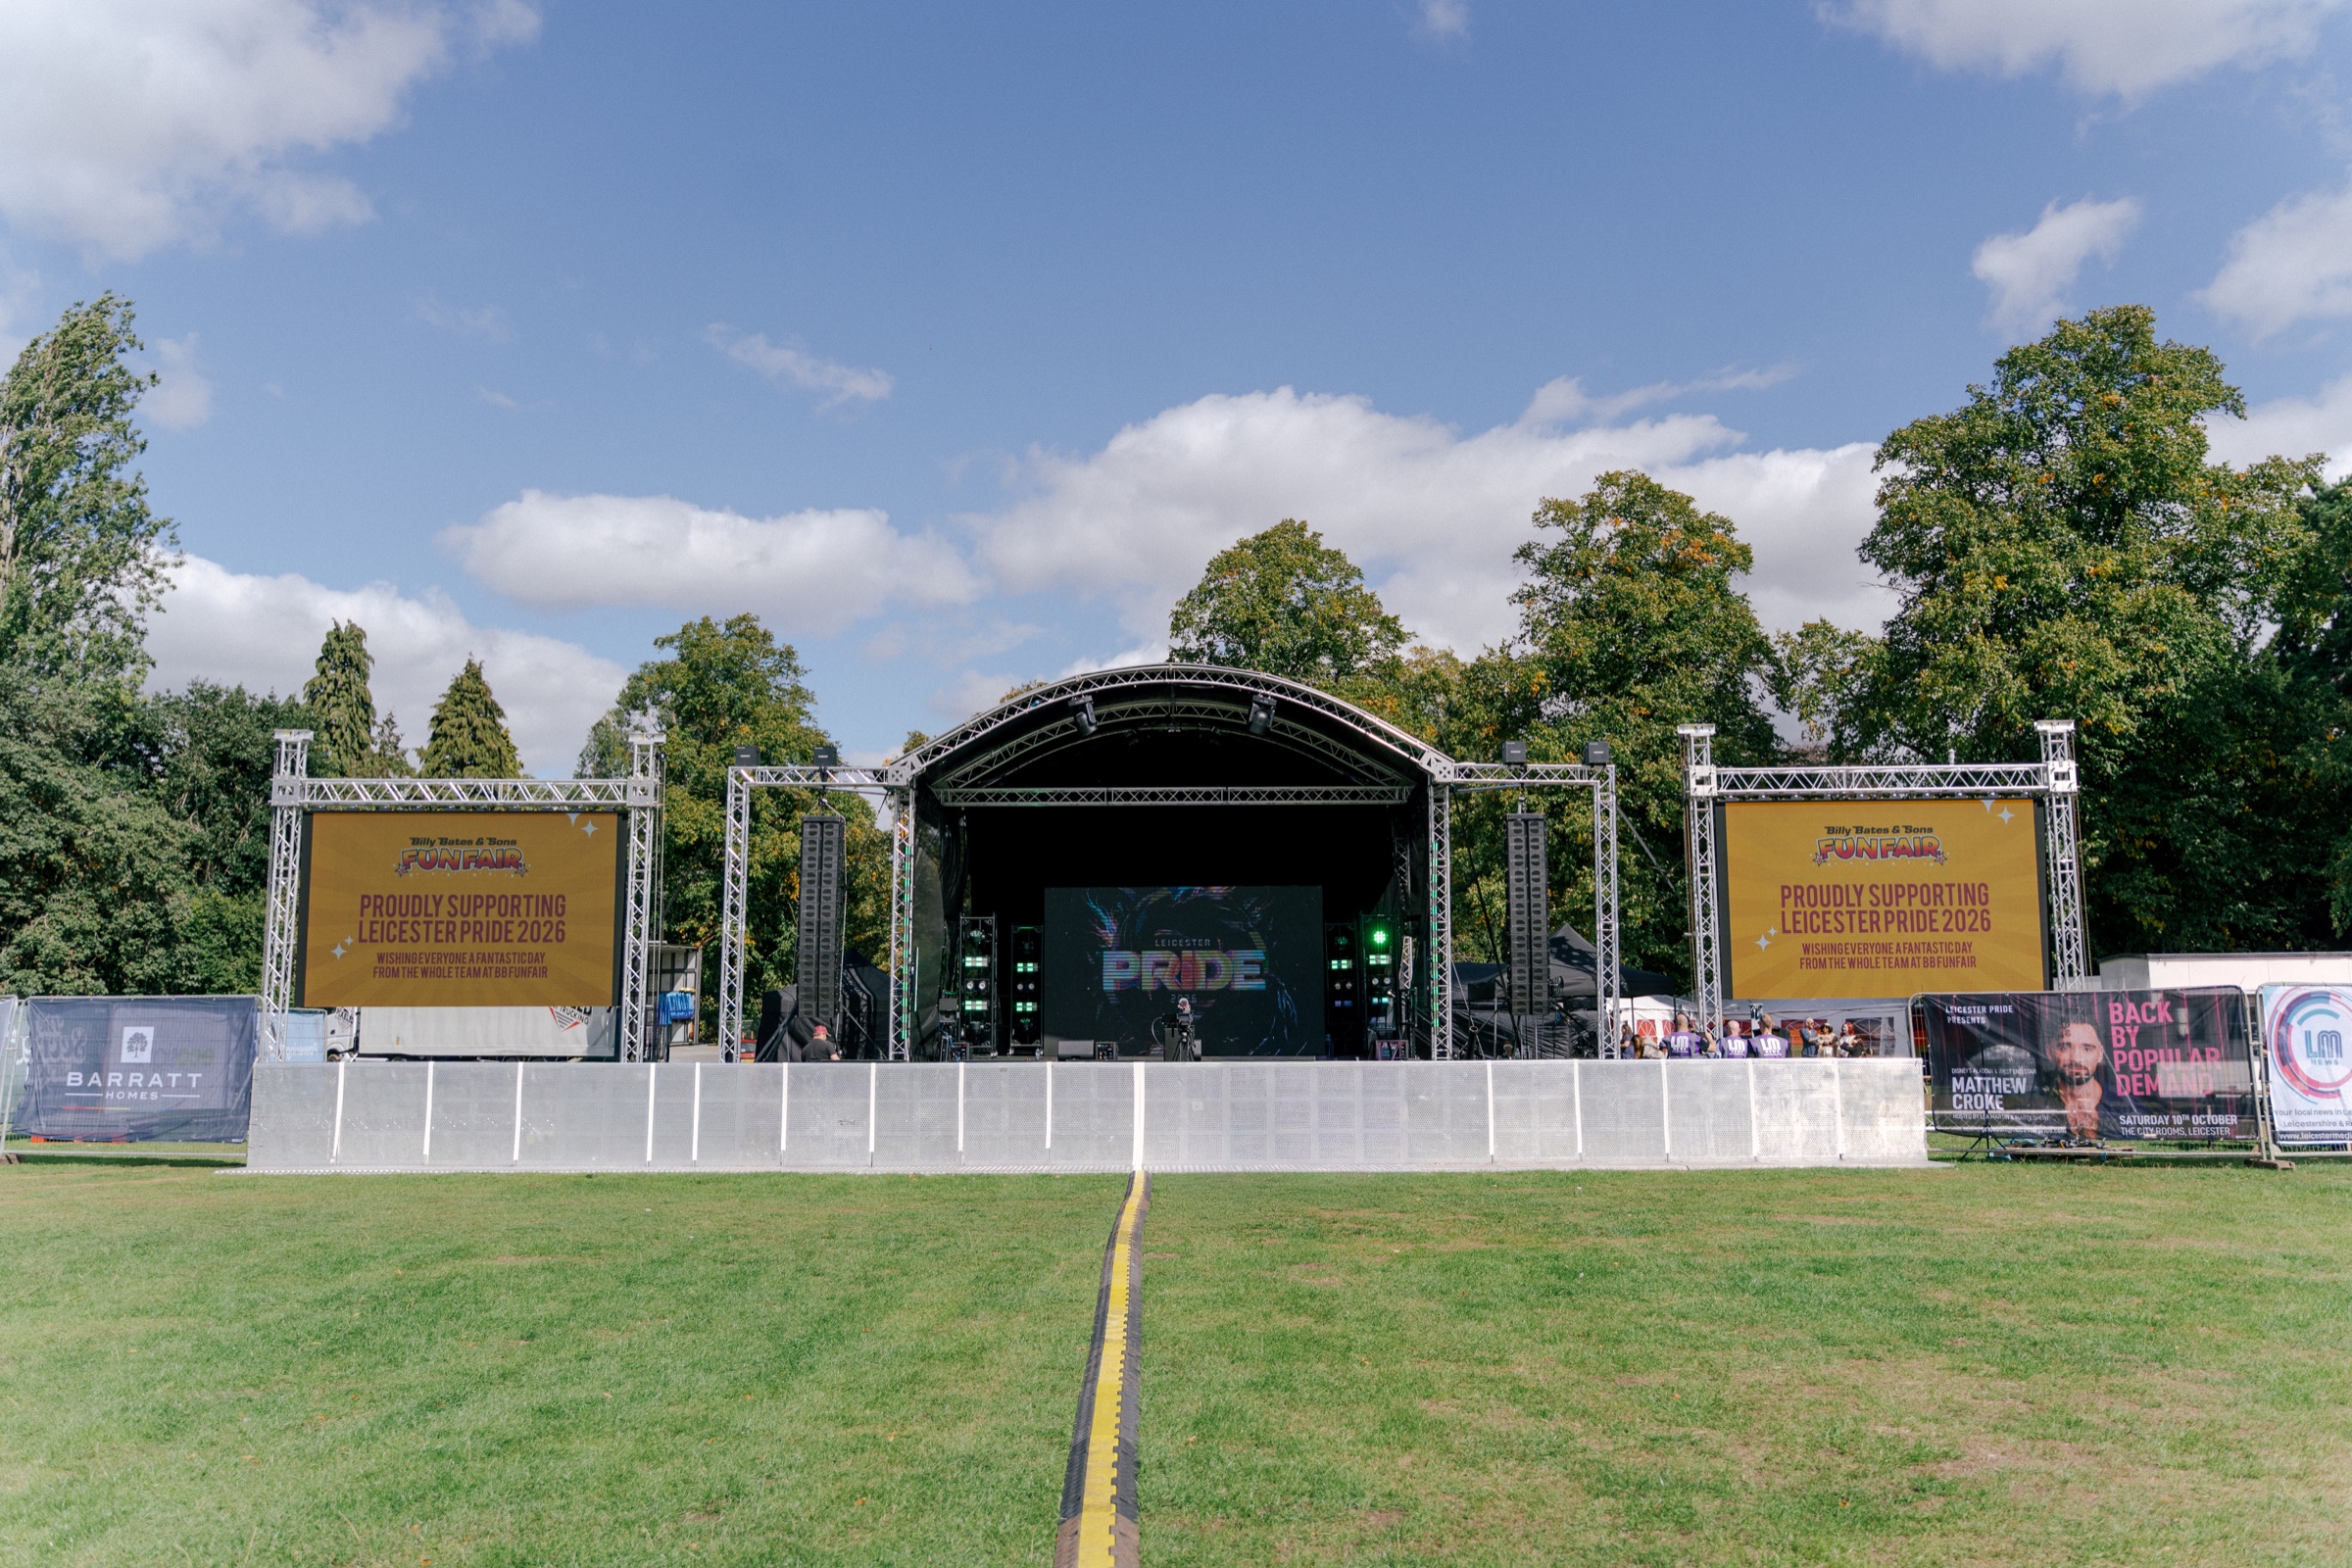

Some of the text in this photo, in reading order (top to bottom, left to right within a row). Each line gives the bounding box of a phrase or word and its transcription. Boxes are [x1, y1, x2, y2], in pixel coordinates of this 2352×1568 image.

[1825, 825, 1933, 836] Billy Bates & Sons
[410, 837, 517, 848] Billy Bates & Sons
[1780, 882, 1989, 907] PROUDLY SUPPORTING
[360, 894, 566, 917] PROUDLY SUPPORTING
[1781, 908, 1991, 934] LEICESTER PRIDE 2026
[358, 919, 566, 943] LEICESTER PRIDE 2026
[1801, 941, 1973, 955] WISHING EVERYONE A FANTASTIC DAY
[376, 953, 546, 964] WISHING EVERYONE A FANTASTIC DAY
[1799, 956, 1977, 969] FROM THE WHOLE TEAM AT BB FUNFAIR
[373, 966, 548, 978] FROM THE WHOLE TEAM AT BB FUNFAIR
[1102, 950, 1267, 991] PRIDE
[1946, 1015, 1985, 1024] PRESENTS
[2109, 1001, 2174, 1024] BACK
[2111, 1025, 2140, 1049] BY
[2113, 1048, 2223, 1072] POPULAR
[67, 1071, 202, 1088] BARRATT
[1952, 1076, 2027, 1094] MATTHEW
[2116, 1072, 2215, 1096] DEMAND
[105, 1091, 159, 1100] HOMES
[1952, 1094, 2005, 1110] CROKE
[2119, 1115, 2170, 1125] SATURDAY
[2191, 1114, 2238, 1125] OCTOBER
[2156, 1127, 2187, 1137] ROOMS,
